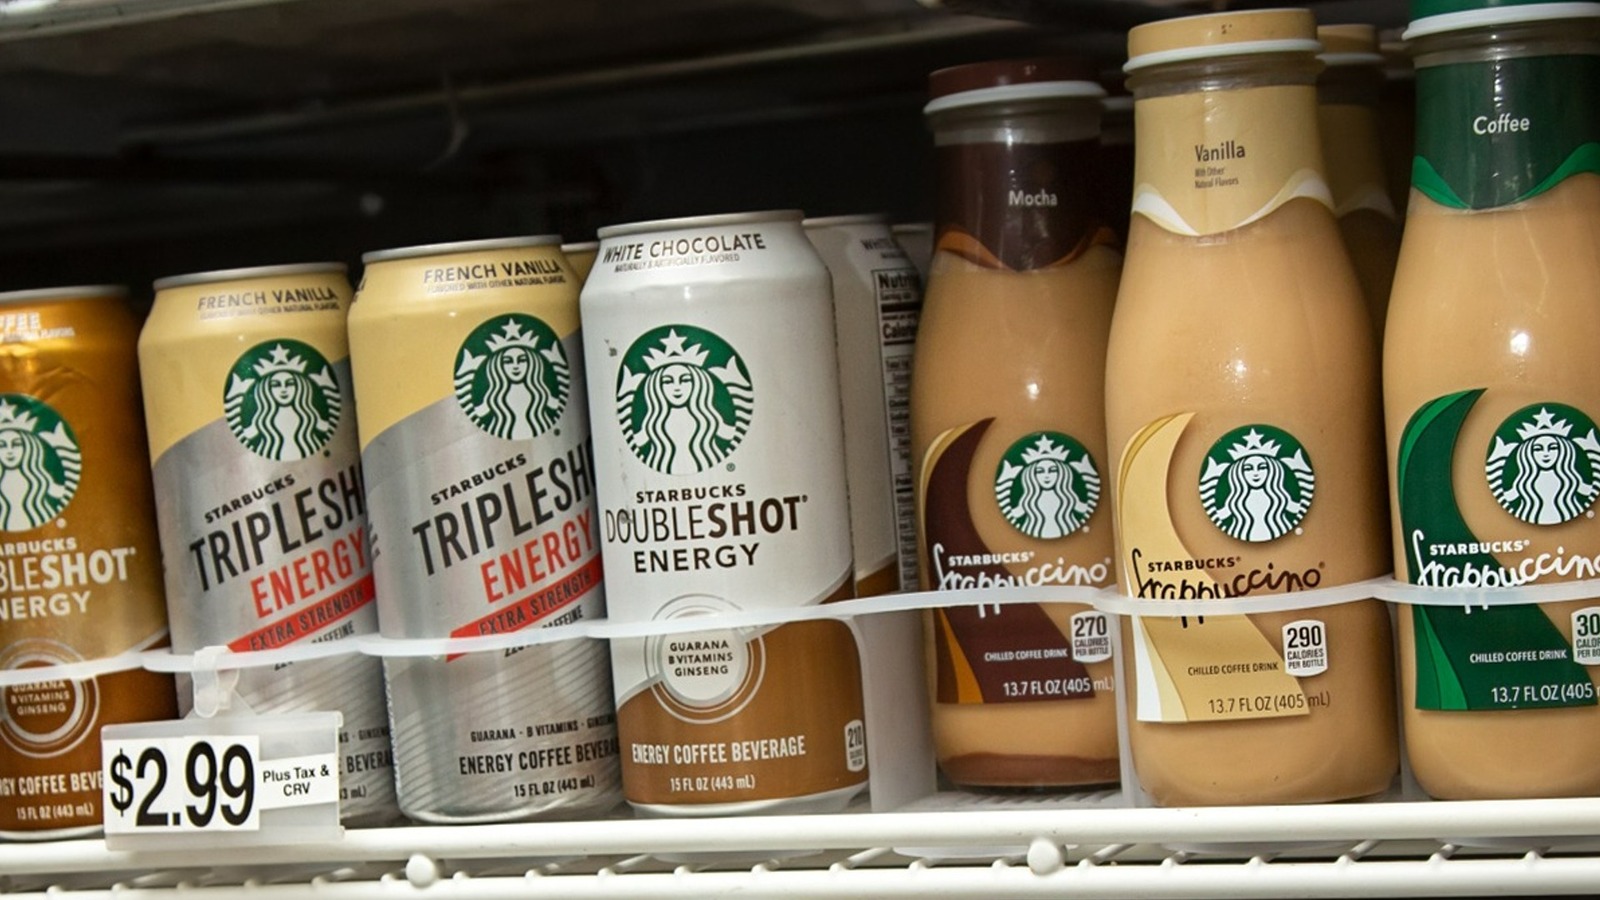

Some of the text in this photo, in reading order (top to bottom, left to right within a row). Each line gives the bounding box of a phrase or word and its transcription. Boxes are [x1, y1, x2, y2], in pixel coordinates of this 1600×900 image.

[1473, 114, 1530, 136] Coffee
[1195, 141, 1246, 162] Vanilla
[1009, 188, 1058, 207] Mocha
[603, 233, 766, 263] WHITE CHOCOLATE
[424, 258, 564, 284] FRENCH VANILLA
[197, 287, 339, 310] FRENCH VANILLA
[431, 453, 527, 506] STARBUCKS
[204, 473, 296, 524] STARBUCKS
[636, 483, 746, 504] STARBUCKS
[412, 435, 596, 577] TRIPLESH
[189, 462, 367, 592] TRIPLESH
[605, 495, 801, 544] DOUBLESHOT
[480, 508, 594, 604] ENERGY
[634, 542, 760, 573] ENERGY
[1430, 540, 1524, 556] STARBUCKS
[948, 552, 1030, 567] STARBUCKS
[1148, 556, 1236, 572] STARBUCKS
[250, 525, 367, 619] ENERGY
[479, 570, 592, 636] EXTRA STRENGTH
[251, 585, 364, 651] EXTRA STRENGTH
[1074, 615, 1108, 638] 270
[669, 639, 730, 653] GUARANA
[1074, 636, 1109, 648] CALORIES
[1286, 625, 1323, 649] 290
[668, 651, 734, 665] B VITAMINS
[984, 648, 1069, 662] CHILLED COFFEE DRINK
[1075, 648, 1087, 657] PER
[1287, 648, 1325, 661] CALORIES
[1469, 649, 1568, 664] CHILLED COFFEE DRINK
[1577, 648, 1591, 659] PER
[674, 664, 729, 677] GINSENG
[1187, 661, 1279, 676] CHILLED COFFEE DRINK
[1288, 658, 1325, 670] PER BOTTLE
[12, 679, 67, 693] GUARANA
[1003, 675, 1115, 697] 13.7 FL OZ (405 mL)
[1491, 686, 1521, 703] 13.7
[1524, 685, 1539, 702] FL
[1540, 684, 1559, 701] OZ
[1560, 682, 1593, 702] (405
[18, 690, 70, 704] VITAMINS
[1208, 690, 1331, 714] 13.7 FL OZ (405 mL)
[17, 702, 67, 716] GINSENG
[470, 728, 516, 744] GUARANA
[526, 726, 534, 738] B
[535, 720, 579, 738] VITAMINS
[632, 735, 807, 765] ENERGY COFFEE BEVERAGE
[459, 753, 514, 776] ENERGY
[518, 746, 573, 771] COFFEE
[18, 773, 67, 796] COFFEE
[110, 740, 256, 828] $2.99
[262, 766, 331, 784] Plus Tax &
[670, 774, 756, 792] 15 FL OZ (443 mL)
[283, 781, 311, 797] CRV
[514, 784, 526, 798] 15
[529, 781, 541, 796] FL
[543, 780, 555, 795] OZ
[557, 777, 578, 794] (443
[16, 801, 94, 821] 15 FL OZ (443 mL)
